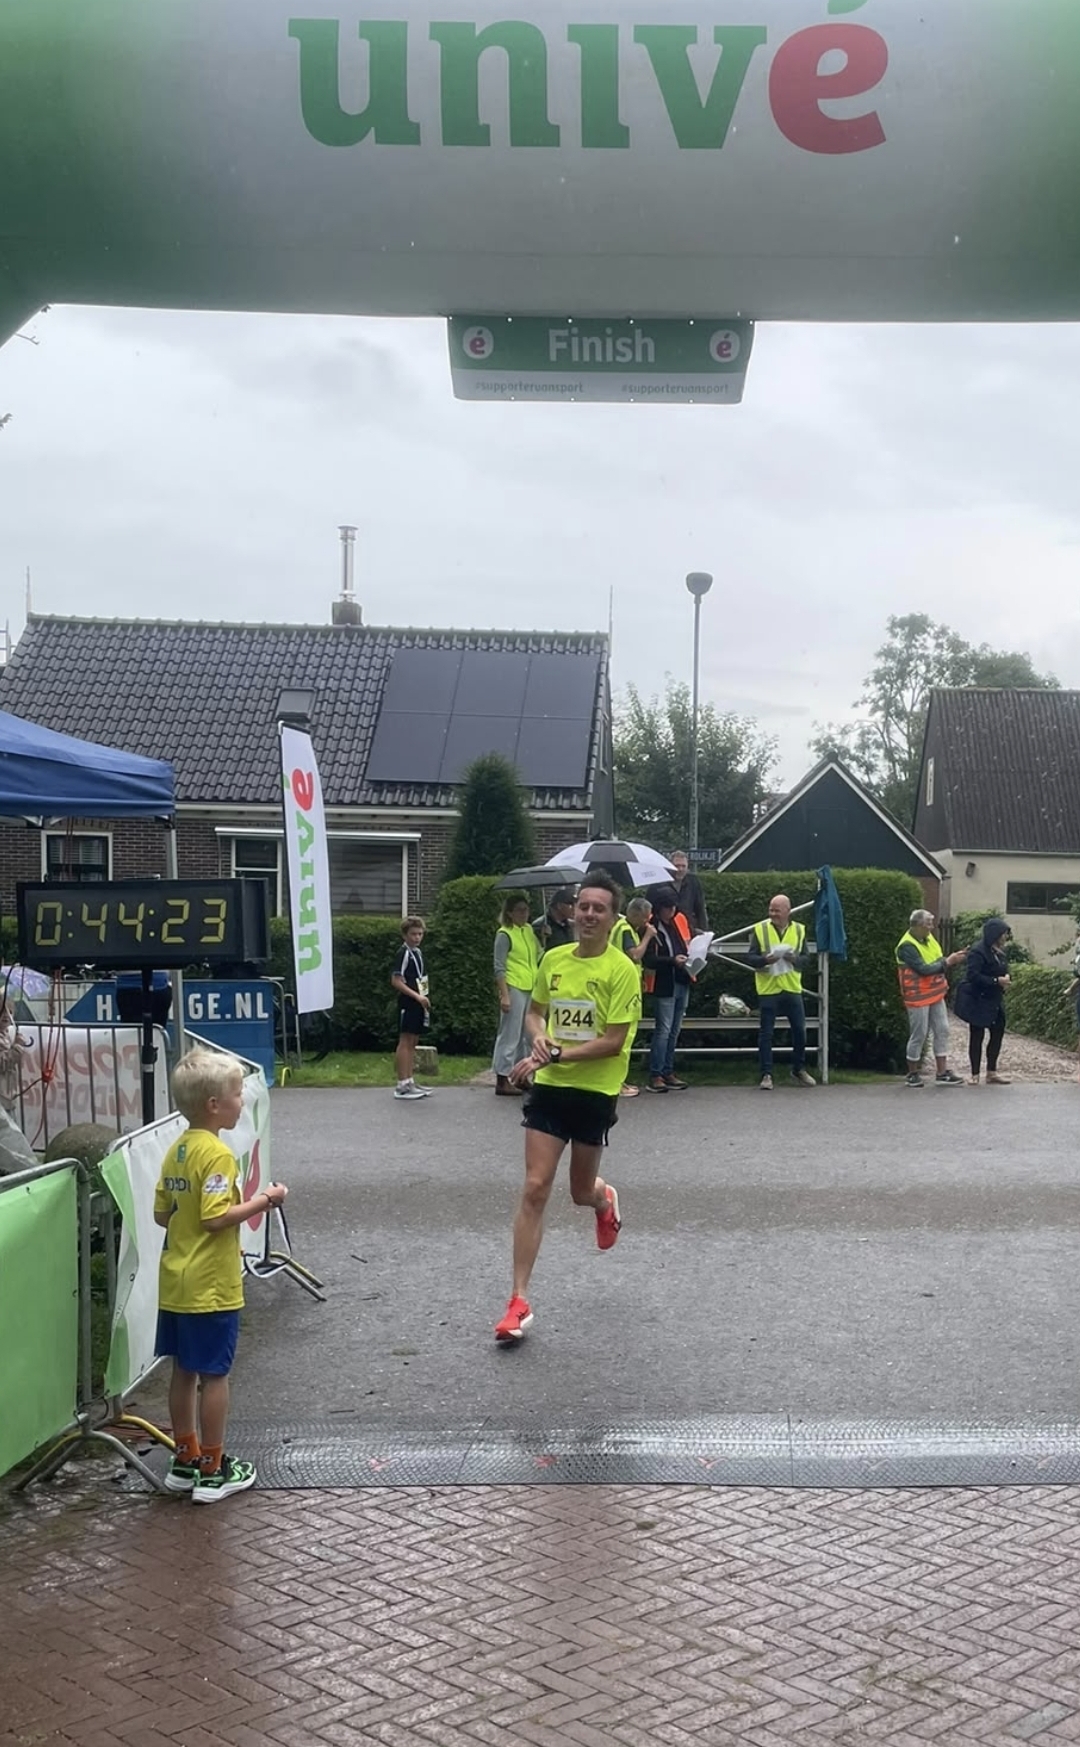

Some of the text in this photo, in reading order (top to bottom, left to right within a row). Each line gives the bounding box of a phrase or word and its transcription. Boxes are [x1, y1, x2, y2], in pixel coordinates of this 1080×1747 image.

[288, 0, 889, 154] univé
[549, 327, 655, 363] Finish
[282, 768, 322, 976] univé
[35, 899, 227, 946] 0:44:23
[554, 1008, 594, 1028] 1244
